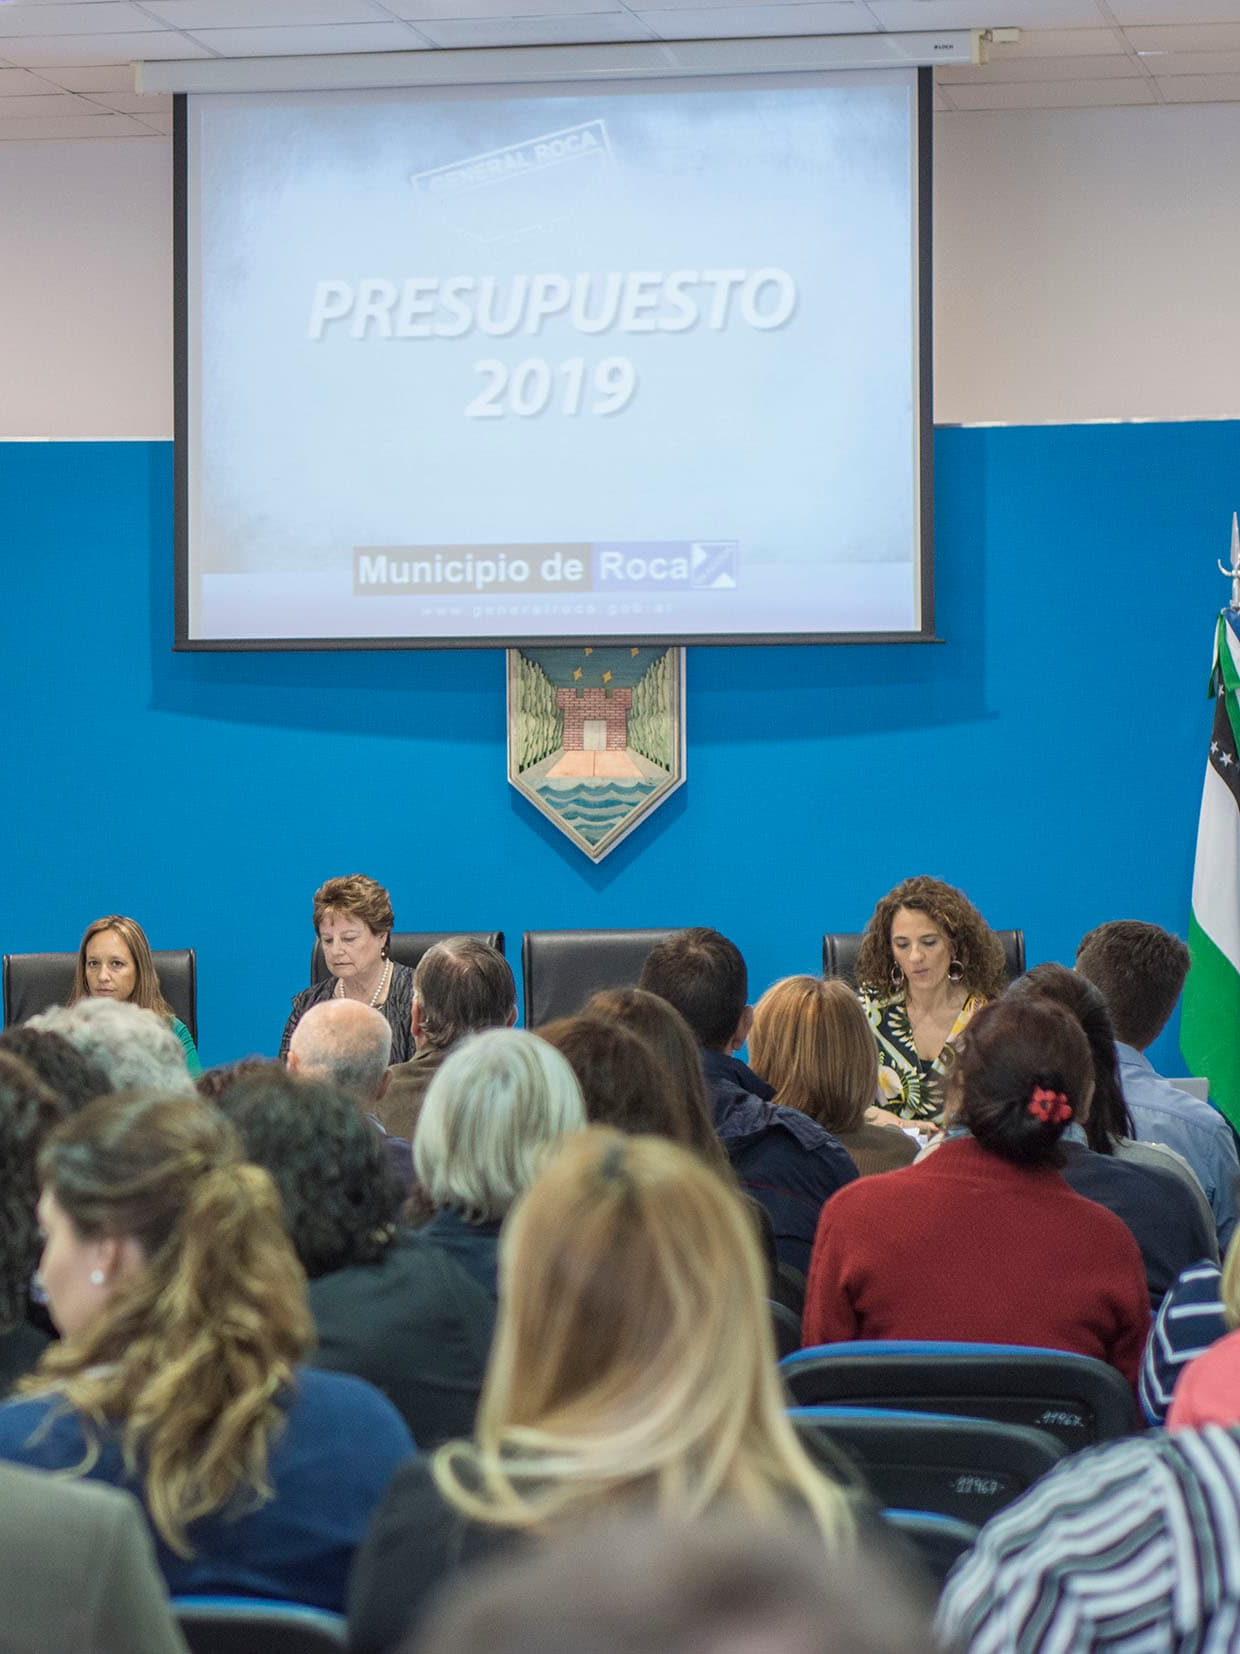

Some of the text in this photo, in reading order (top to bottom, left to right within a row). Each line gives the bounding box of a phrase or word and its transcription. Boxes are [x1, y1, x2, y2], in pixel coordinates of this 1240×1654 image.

[534, 130, 598, 163] ROCA
[307, 267, 799, 341] PRESUPUESTO
[464, 355, 639, 420] 2019
[360, 551, 689, 590] Municipio de Roca
